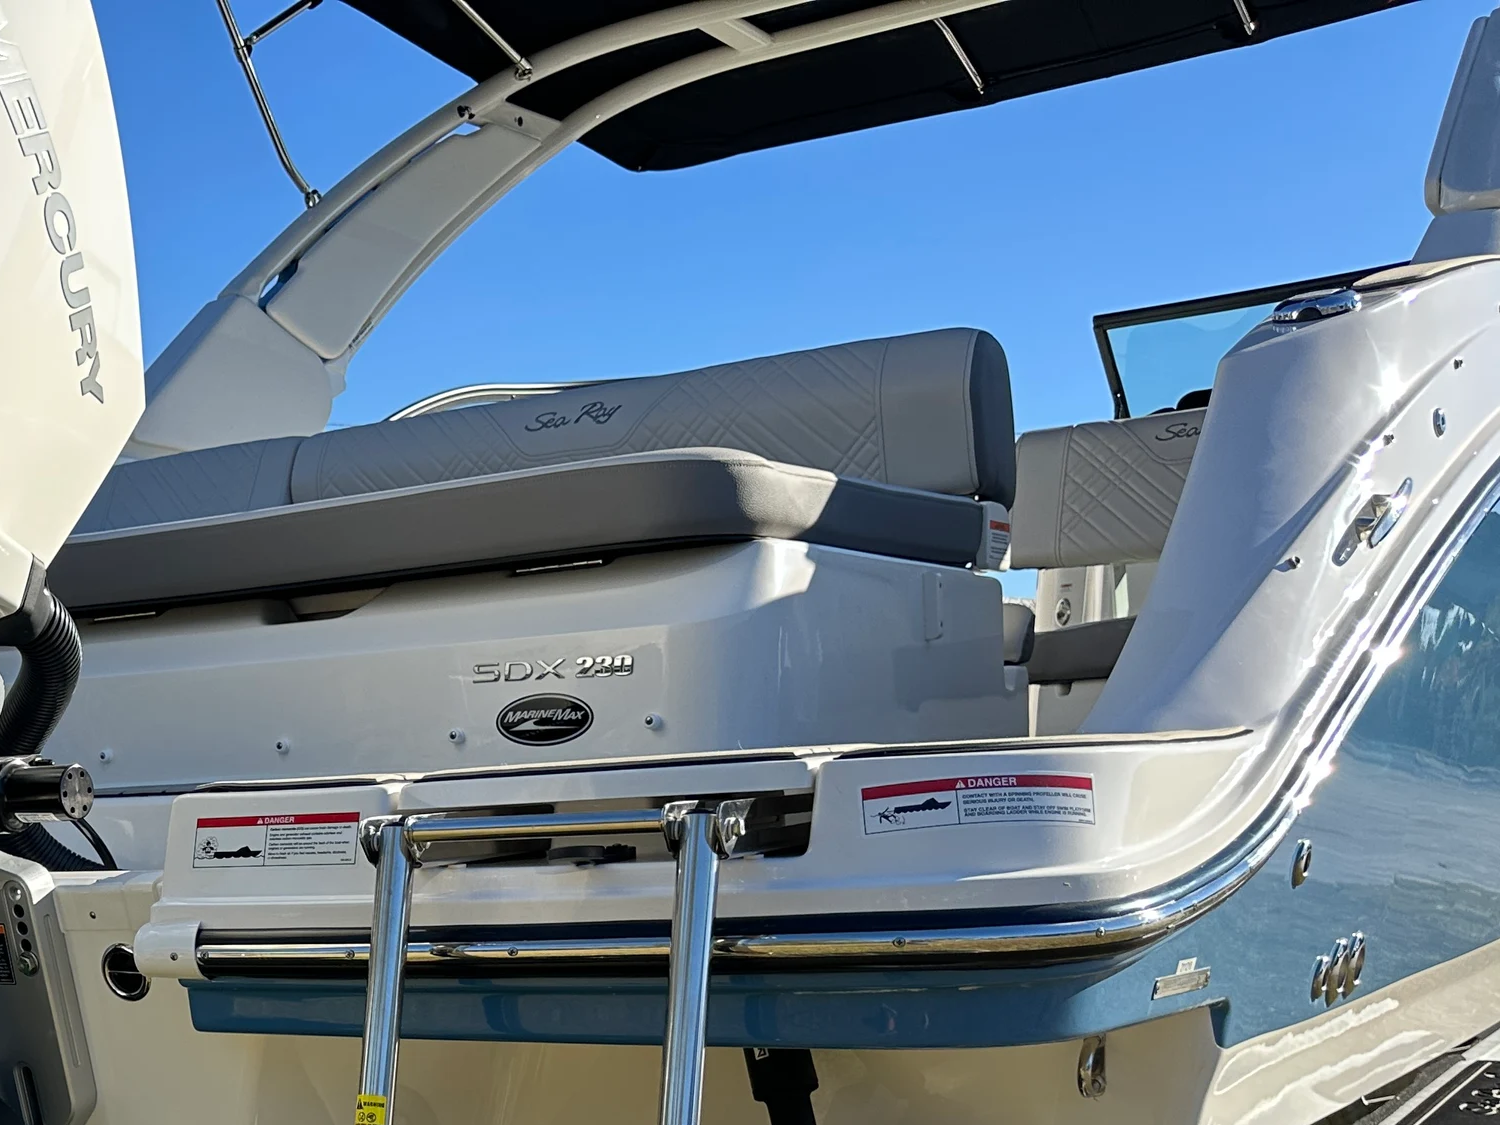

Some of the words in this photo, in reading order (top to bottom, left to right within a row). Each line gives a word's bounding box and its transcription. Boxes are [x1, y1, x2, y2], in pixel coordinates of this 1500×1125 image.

[524, 411, 572, 432] Sea
[573, 401, 622, 425] Ray
[1155, 422, 1201, 441] Sea
[472, 657, 566, 684] SDX
[575, 654, 635, 679] 230
[967, 777, 1017, 788] DANGER
[264, 816, 295, 824] DANGER
